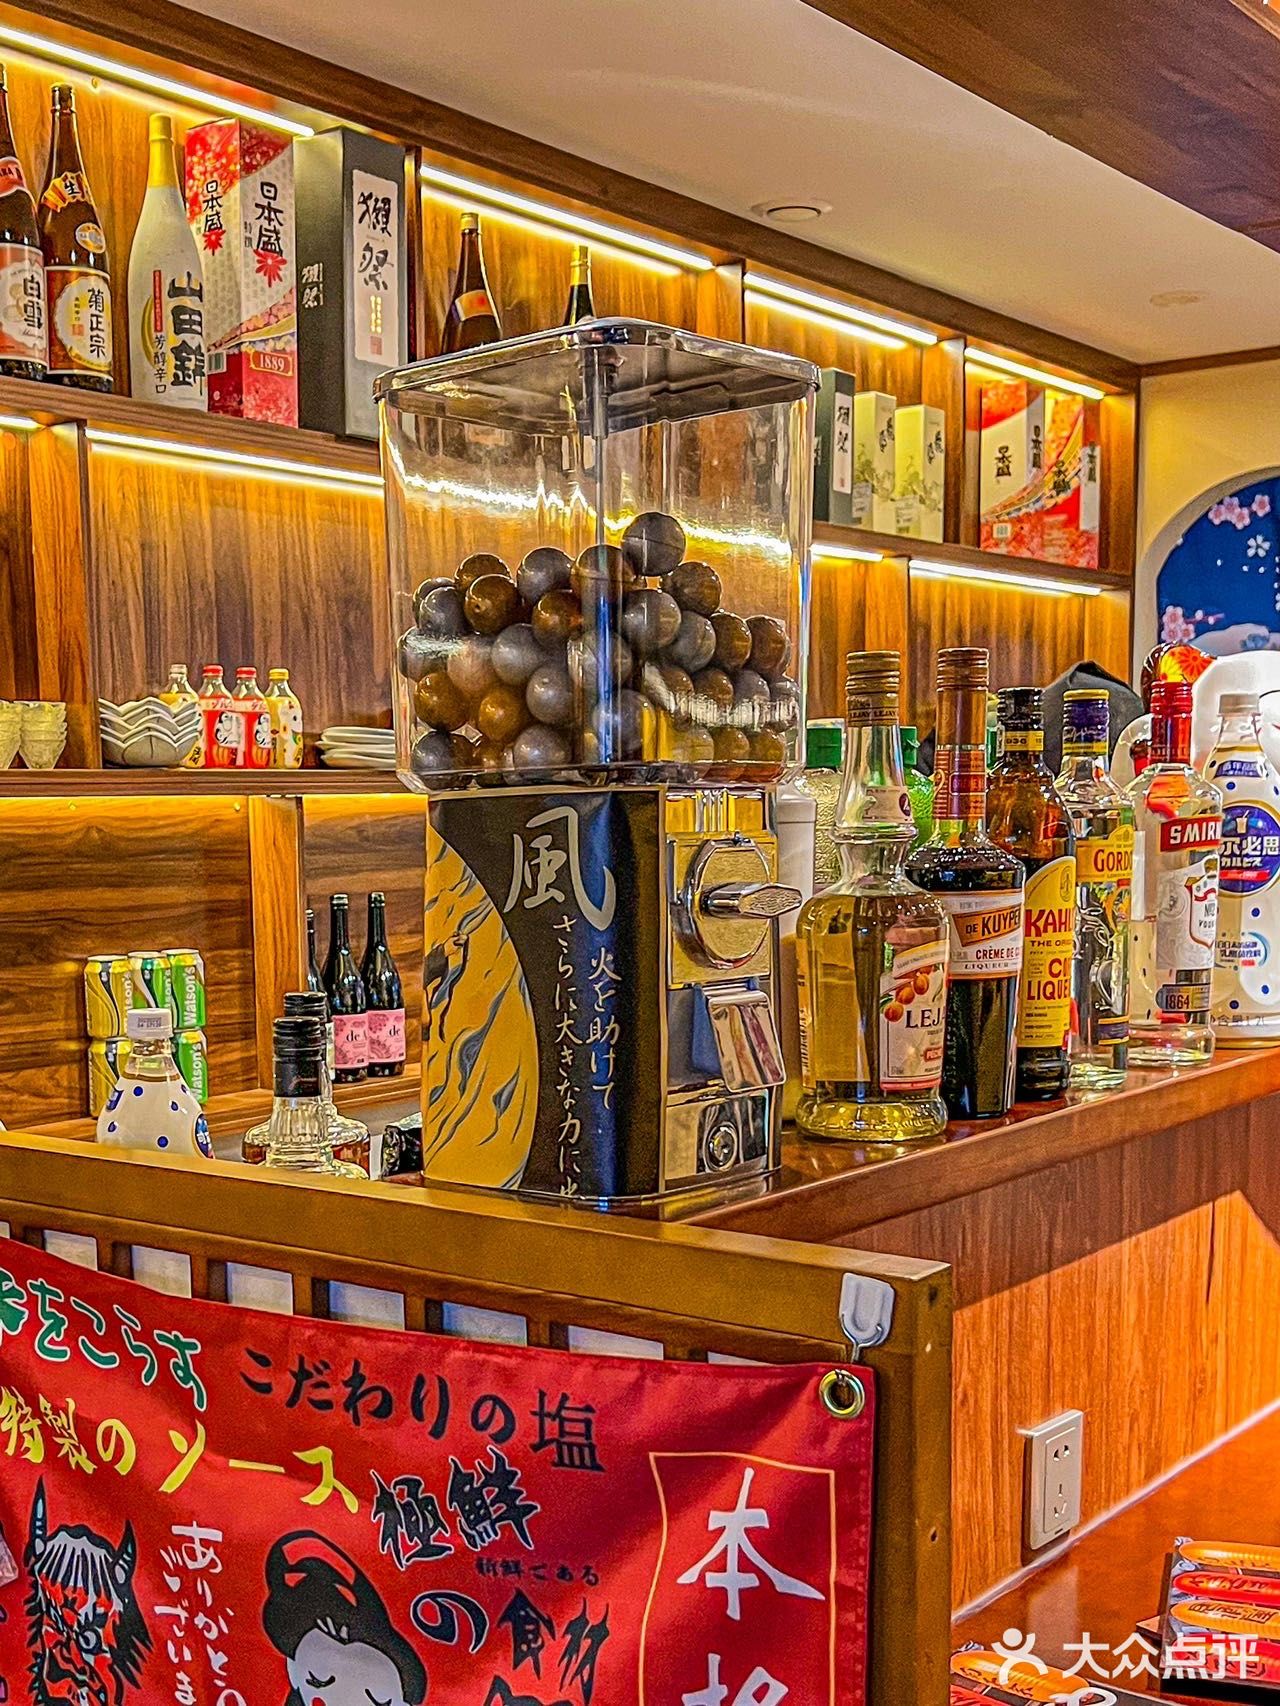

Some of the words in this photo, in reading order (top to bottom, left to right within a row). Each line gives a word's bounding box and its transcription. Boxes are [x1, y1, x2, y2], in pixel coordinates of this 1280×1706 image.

[203, 179, 224, 231] 日本盛
[254, 181, 284, 257] 日本盛
[87, 287, 106, 359] 菊正宗
[153, 334, 166, 394] 芳醇辛口
[258, 351, 286, 371] 1889
[503, 805, 616, 931] 風
[965, 923, 979, 935] DE
[1030, 939, 1053, 947] THE
[183, 965, 197, 1027] Watson's
[1165, 994, 1190, 1010] 1864
[586, 946, 622, 1110] 火を助けて
[239, 1346, 606, 1473] こだわりの塩
[370, 1444, 541, 1572] 極鮮
